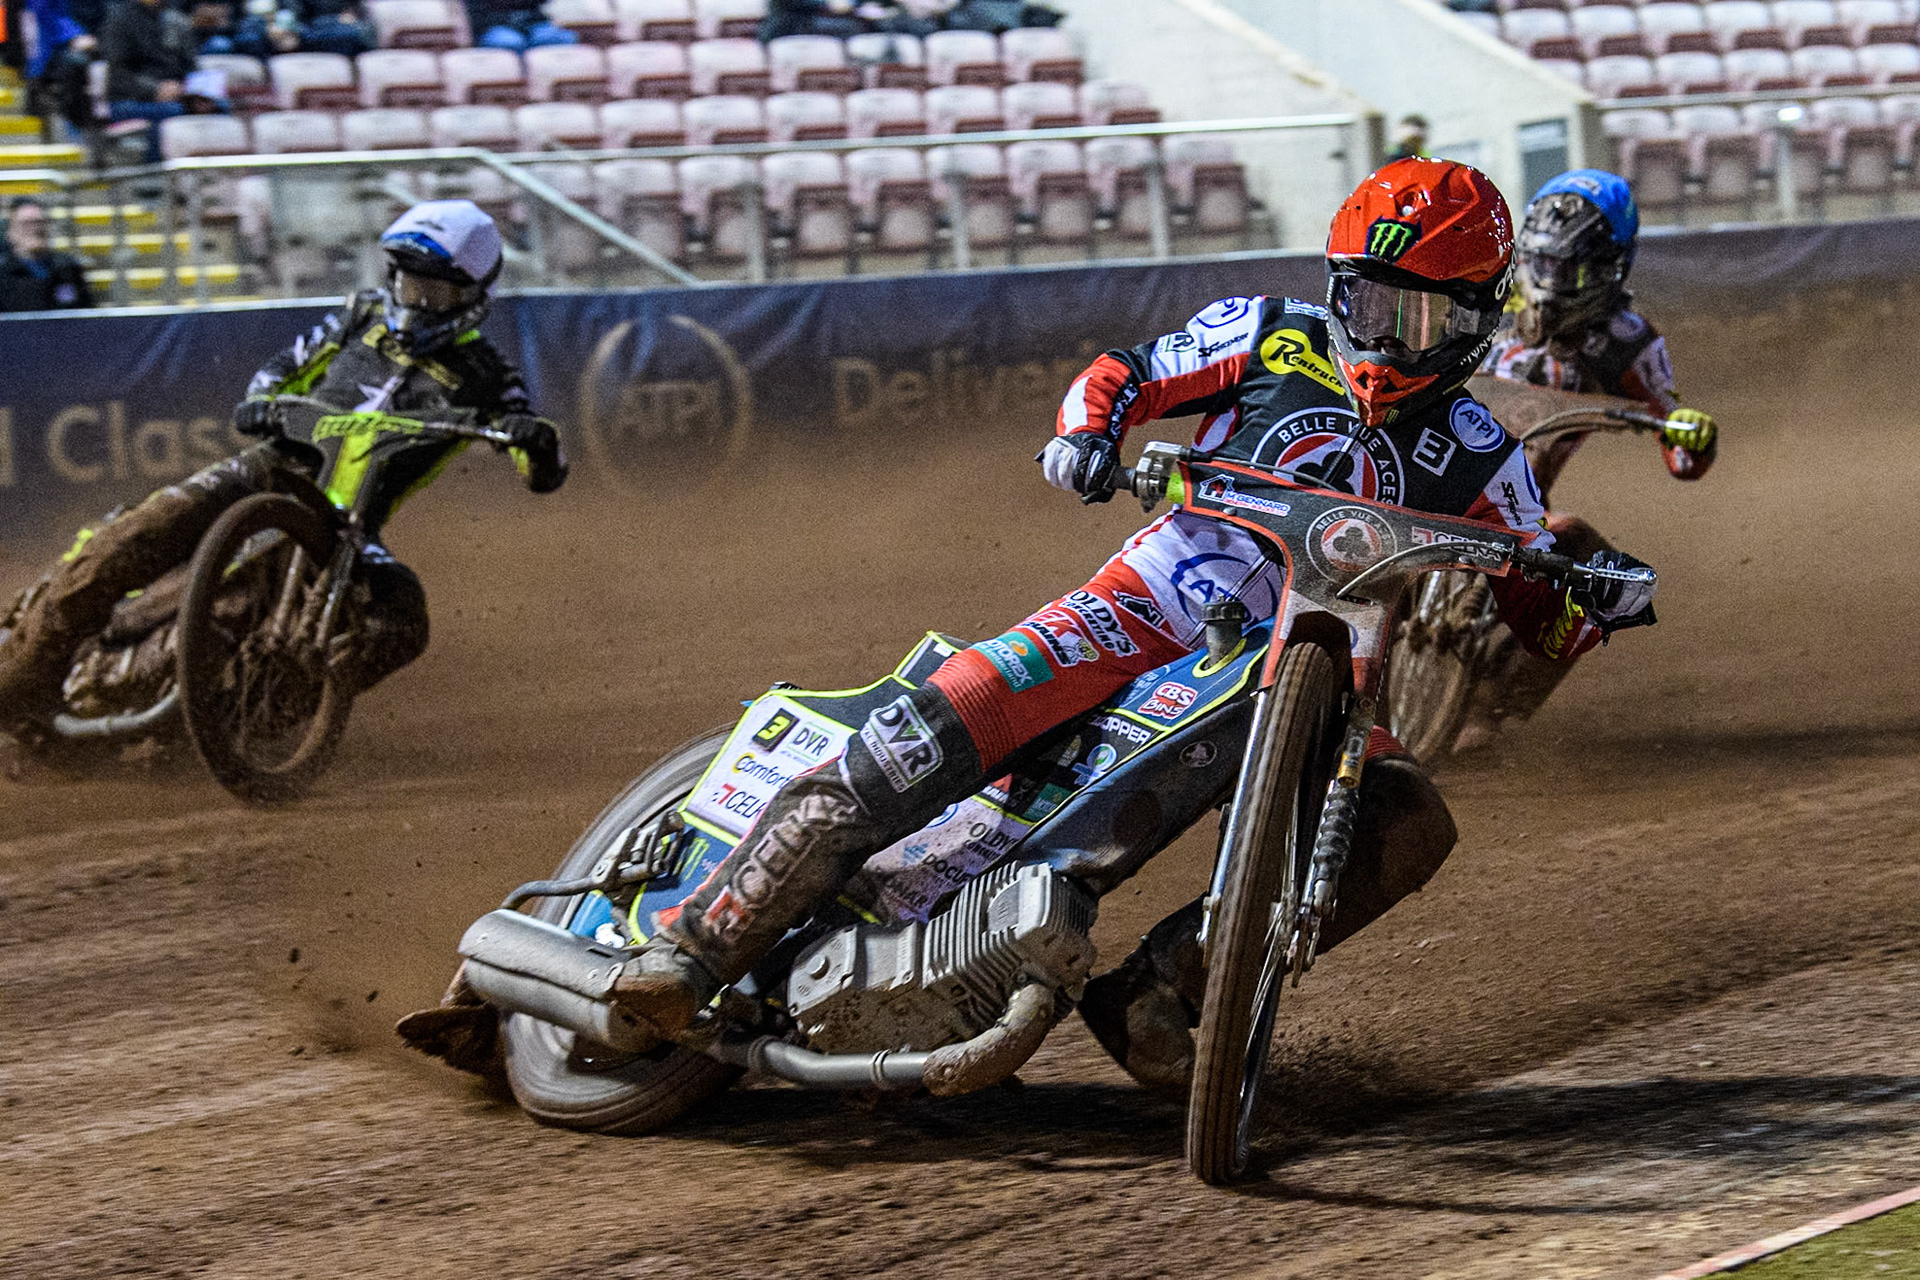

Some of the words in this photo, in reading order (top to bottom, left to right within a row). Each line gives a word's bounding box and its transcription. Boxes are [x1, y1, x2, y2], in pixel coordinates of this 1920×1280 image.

[1277, 416, 1337, 444] BELLE
[1459, 408, 1495, 439] ATPI
[1236, 494, 1289, 512] GENNARD
[1315, 510, 1347, 532] BELLE
[1351, 510, 1373, 523] VUE
[1070, 590, 1137, 653] OLDY'S
[984, 639, 1033, 684] OTOREX
[1142, 699, 1184, 715] BINS
[1156, 685, 1194, 706] CBS
[757, 715, 790, 740] 3
[875, 702, 932, 775] DVR
[792, 727, 829, 757] DVR
